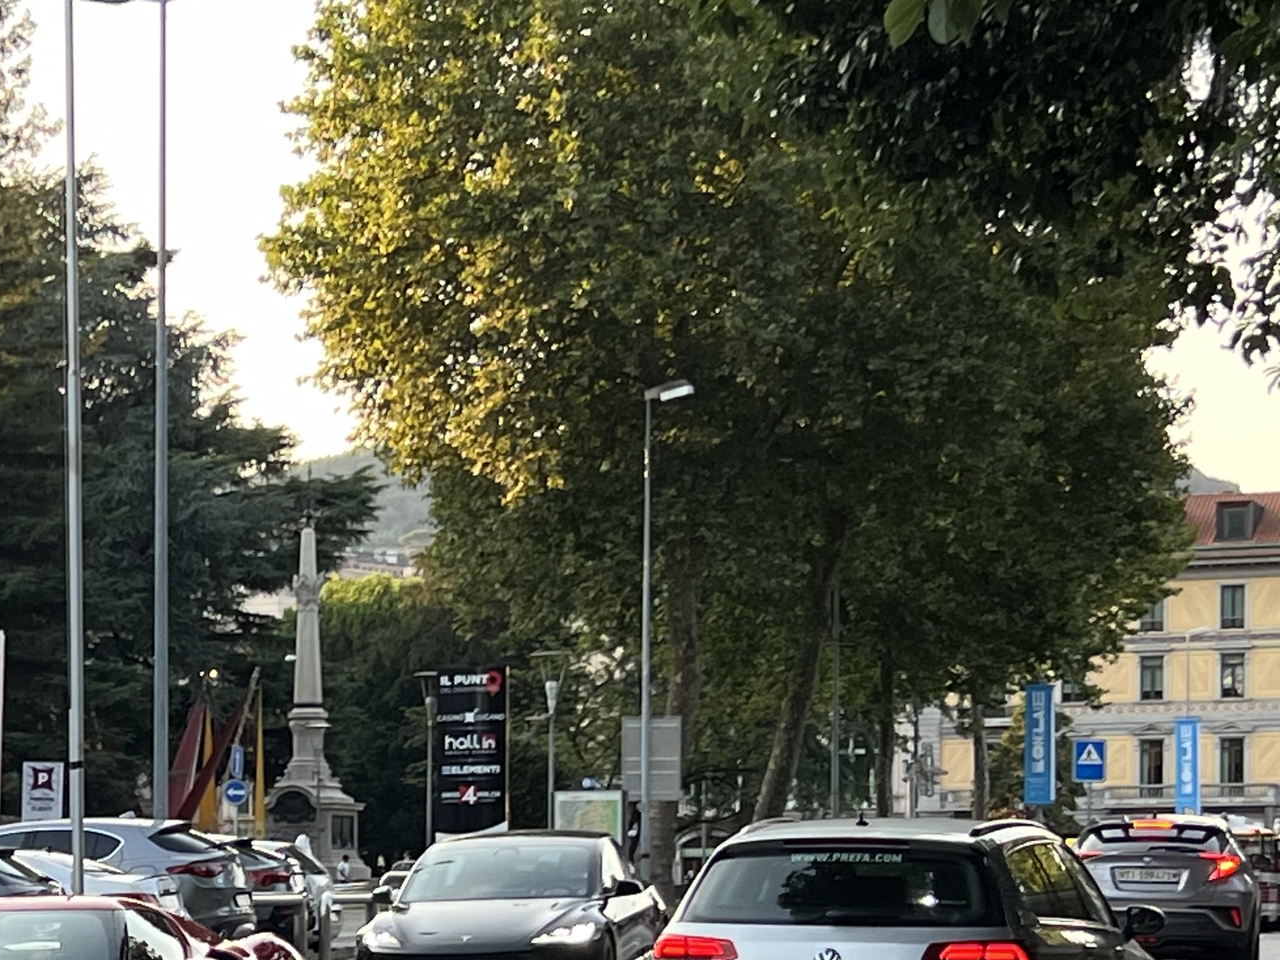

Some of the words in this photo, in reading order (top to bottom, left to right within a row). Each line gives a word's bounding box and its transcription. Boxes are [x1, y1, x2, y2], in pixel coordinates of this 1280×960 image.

[440, 675, 452, 686] IL
[444, 734, 481, 750] hall
[37, 772, 49, 785] P
